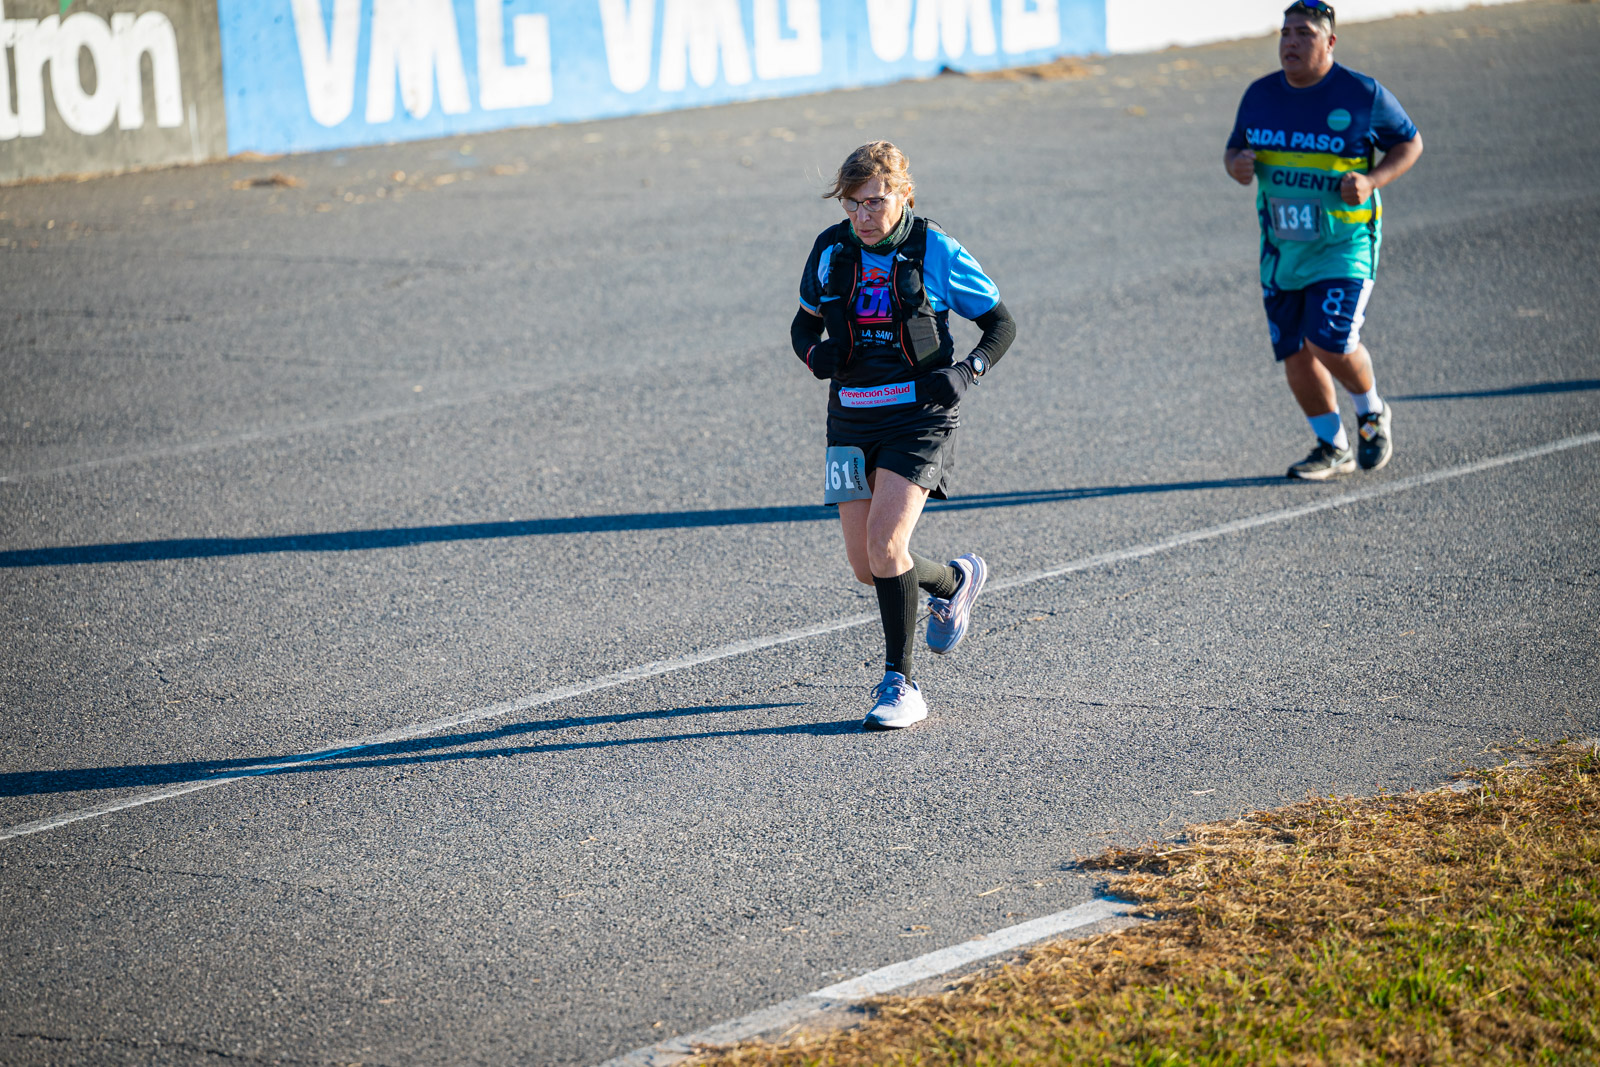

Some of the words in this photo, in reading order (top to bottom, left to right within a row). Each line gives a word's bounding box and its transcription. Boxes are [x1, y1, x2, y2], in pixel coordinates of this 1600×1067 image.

[1290, 131, 1345, 153] PASO
[1279, 204, 1312, 230] 134
[841, 388, 883, 399] Prevención
[883, 384, 910, 396] Salud
